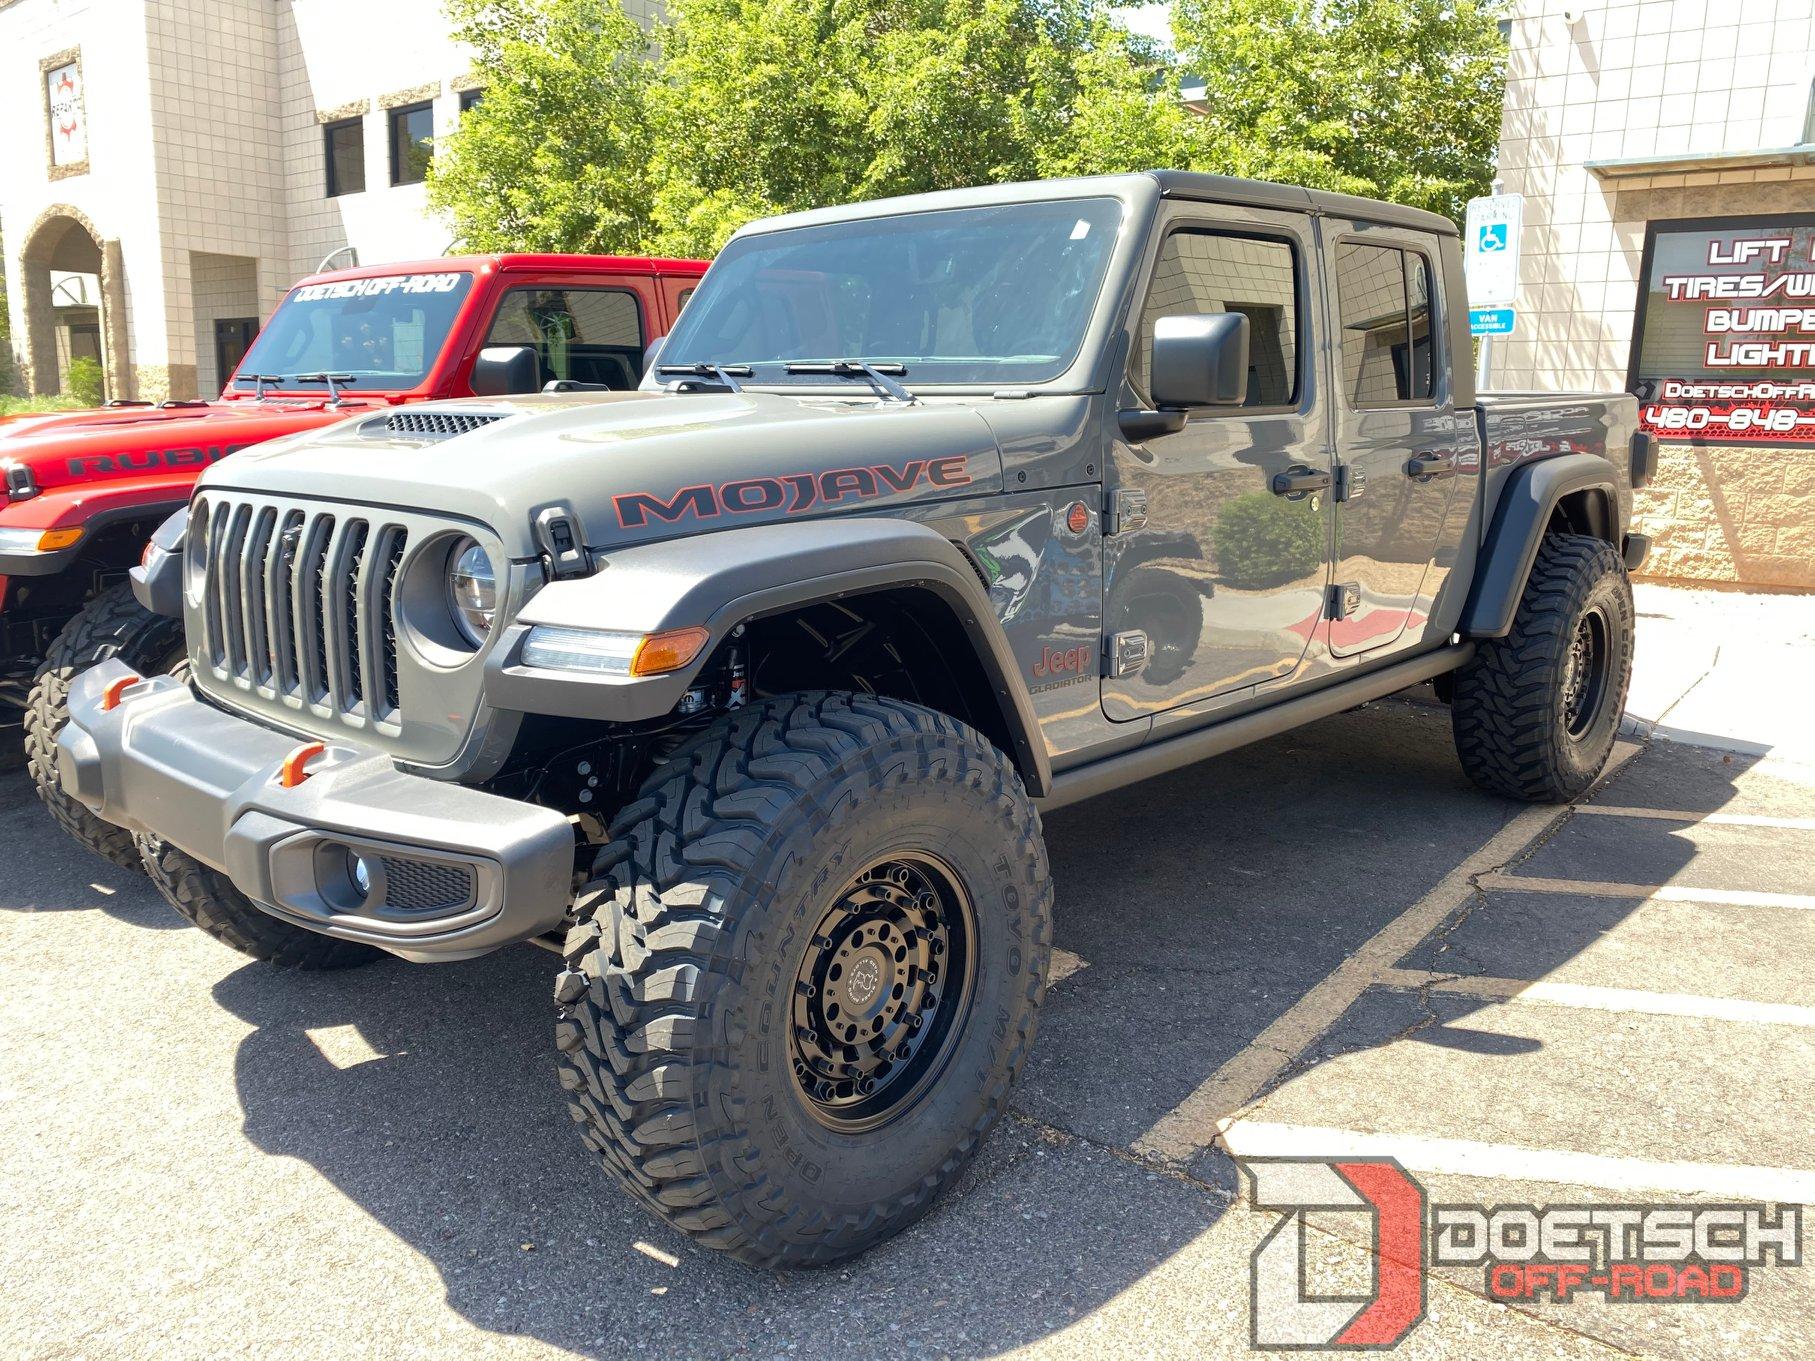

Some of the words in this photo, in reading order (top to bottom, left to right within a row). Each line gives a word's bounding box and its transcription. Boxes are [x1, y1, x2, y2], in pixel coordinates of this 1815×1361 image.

[1709, 238, 1791, 265] LIFT
[1478, 314, 1498, 323] VAN
[610, 455, 973, 529] MOJAVE
[1033, 644, 1091, 677] Jeep
[1029, 674, 1092, 695] GLADIATOR
[993, 854, 1023, 978] TOYO
